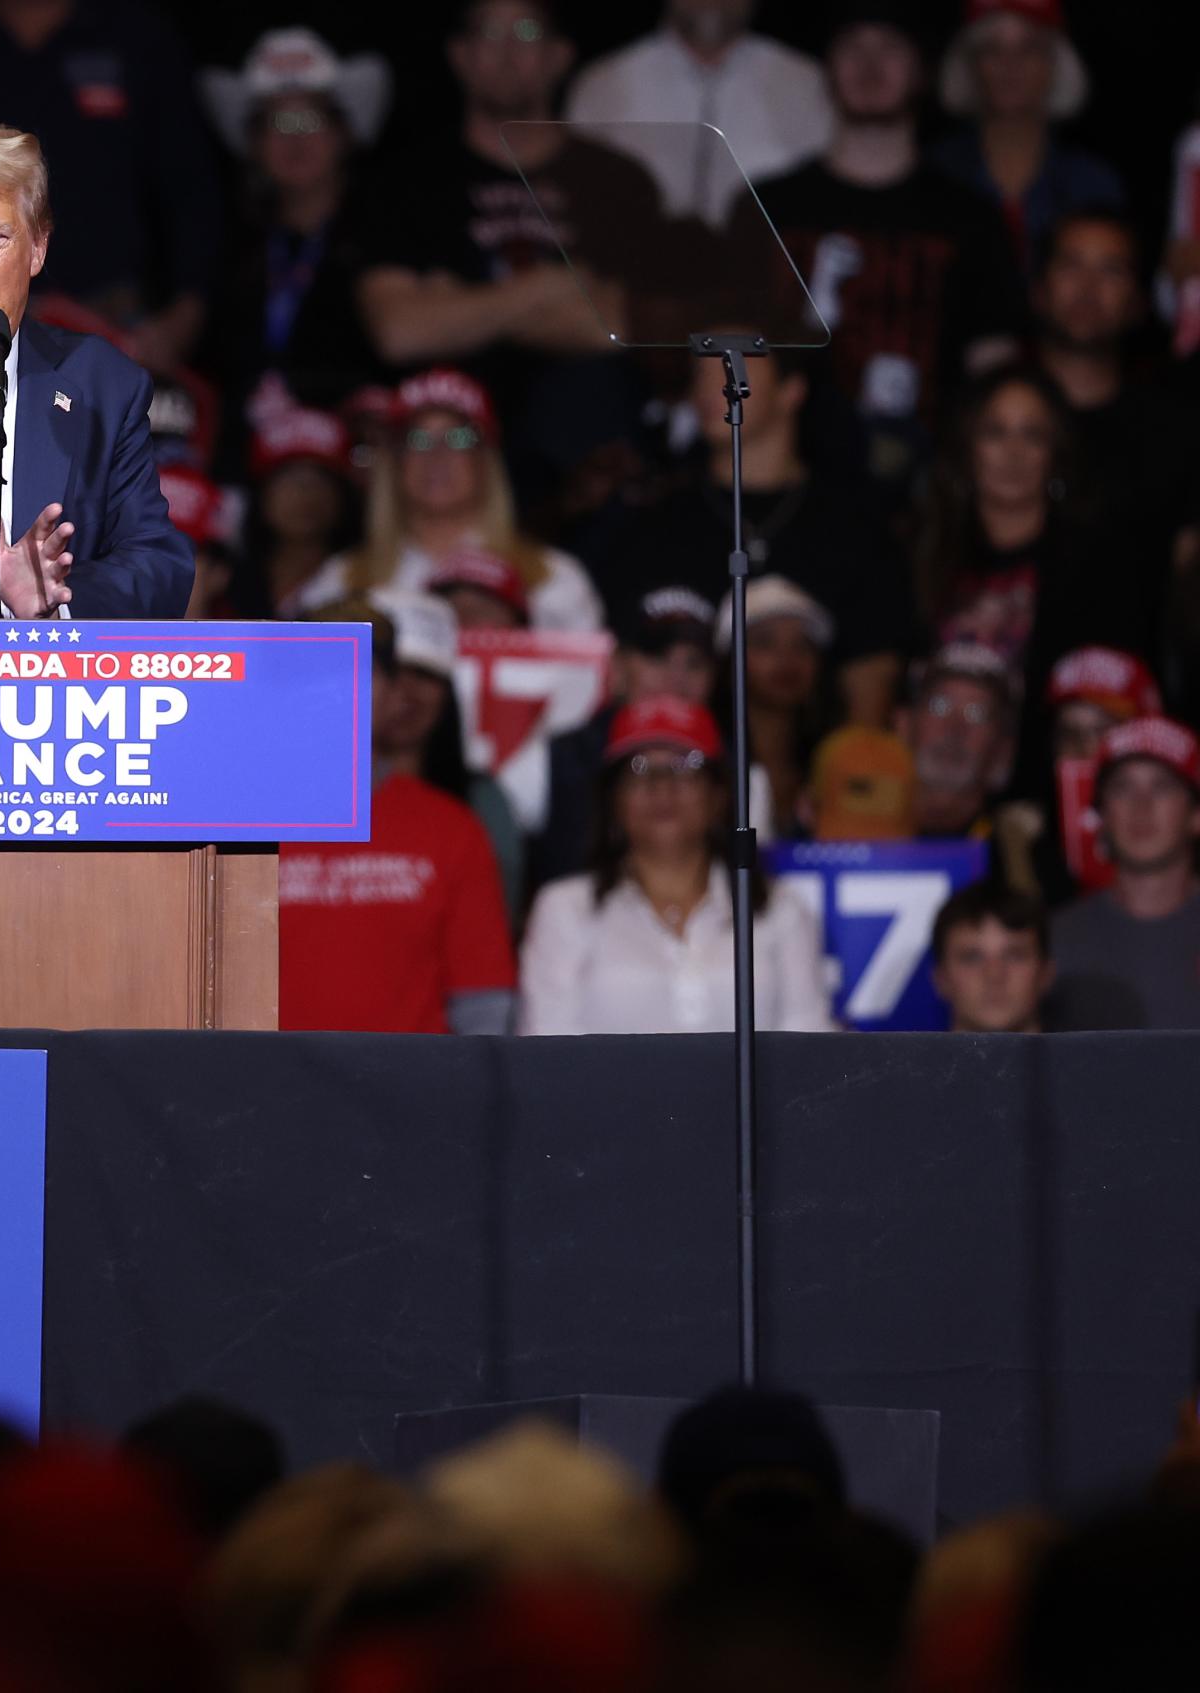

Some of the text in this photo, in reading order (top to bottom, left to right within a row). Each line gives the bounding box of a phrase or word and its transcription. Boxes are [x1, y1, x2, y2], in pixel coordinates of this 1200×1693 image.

[75, 653, 121, 679] TO
[129, 653, 232, 679] 88022
[454, 658, 600, 832] 7
[39, 791, 100, 806] GREAT
[103, 791, 169, 806] AGAIN!
[778, 871, 952, 1020] 7
